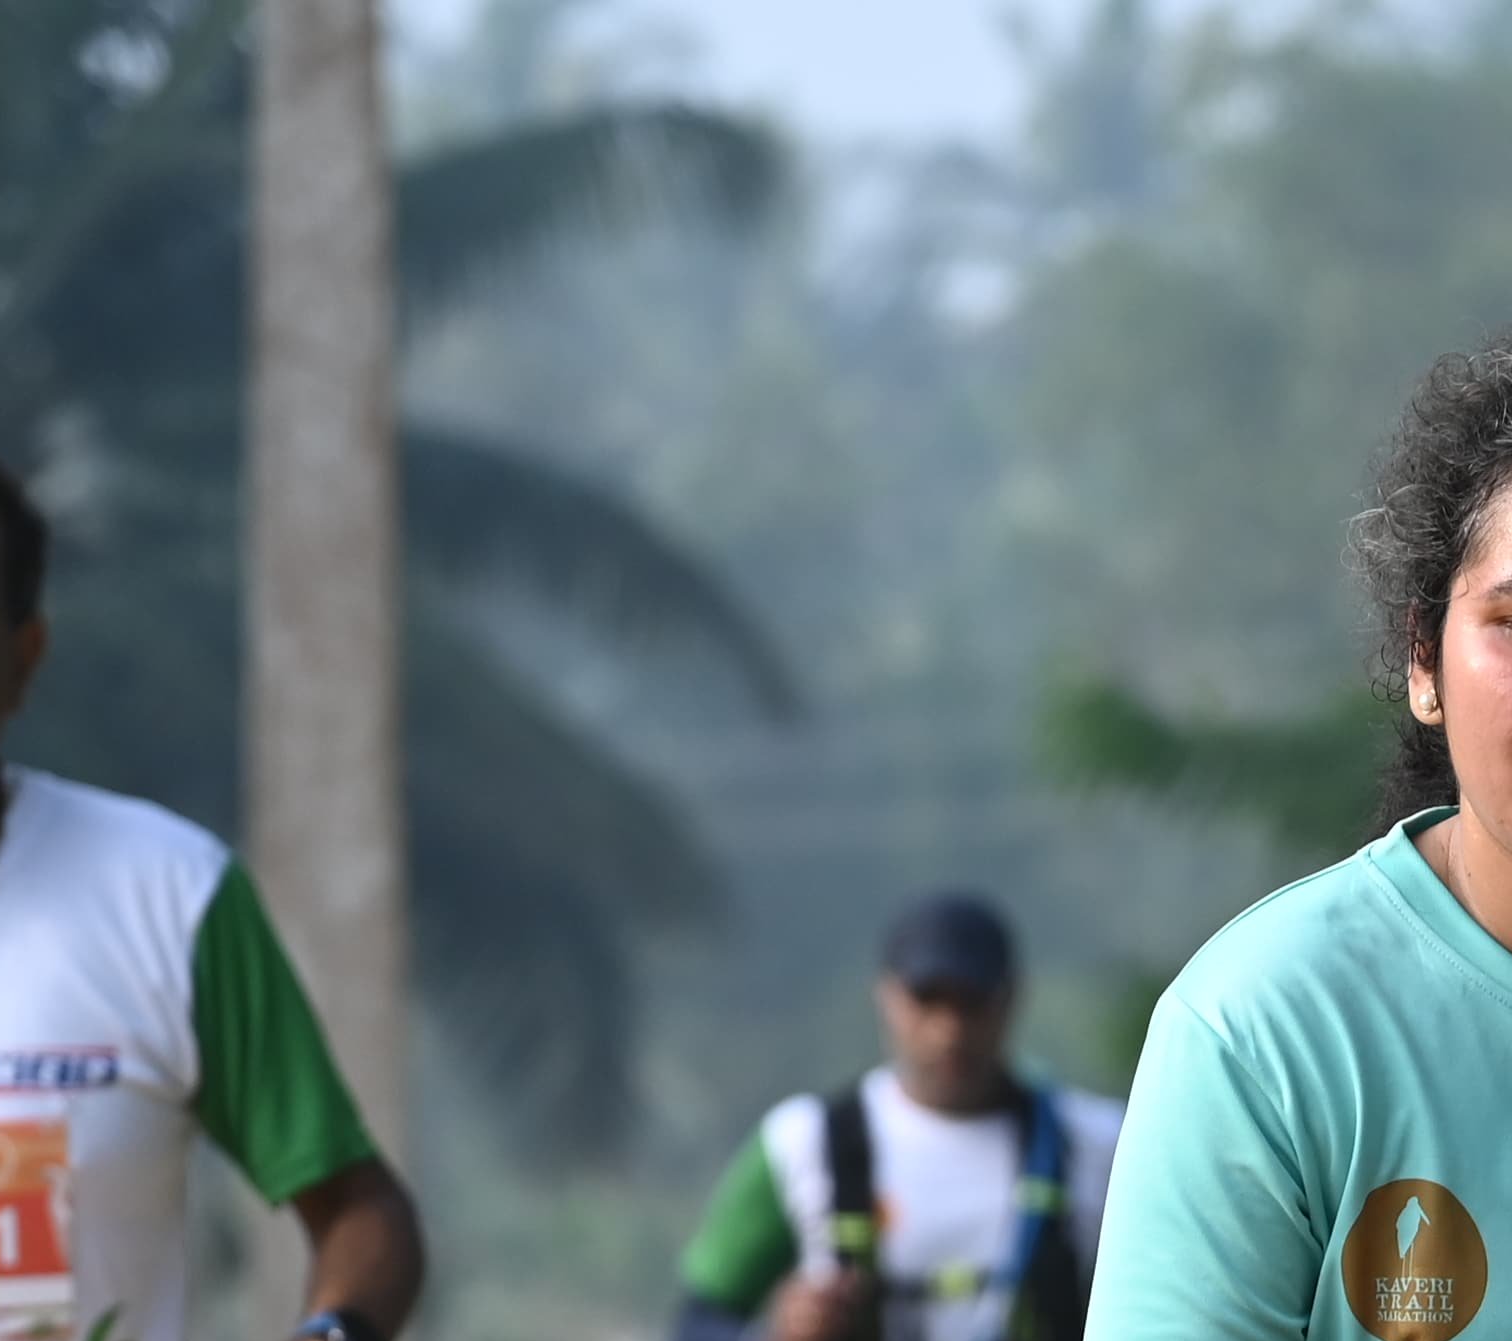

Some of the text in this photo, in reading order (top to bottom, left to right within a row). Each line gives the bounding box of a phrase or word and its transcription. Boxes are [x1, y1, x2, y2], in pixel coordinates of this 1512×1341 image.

[1376, 1277, 1454, 1294] KAVERI
[1376, 1294, 1454, 1310] TRAIL
[1377, 1311, 1454, 1323] MARATHON
